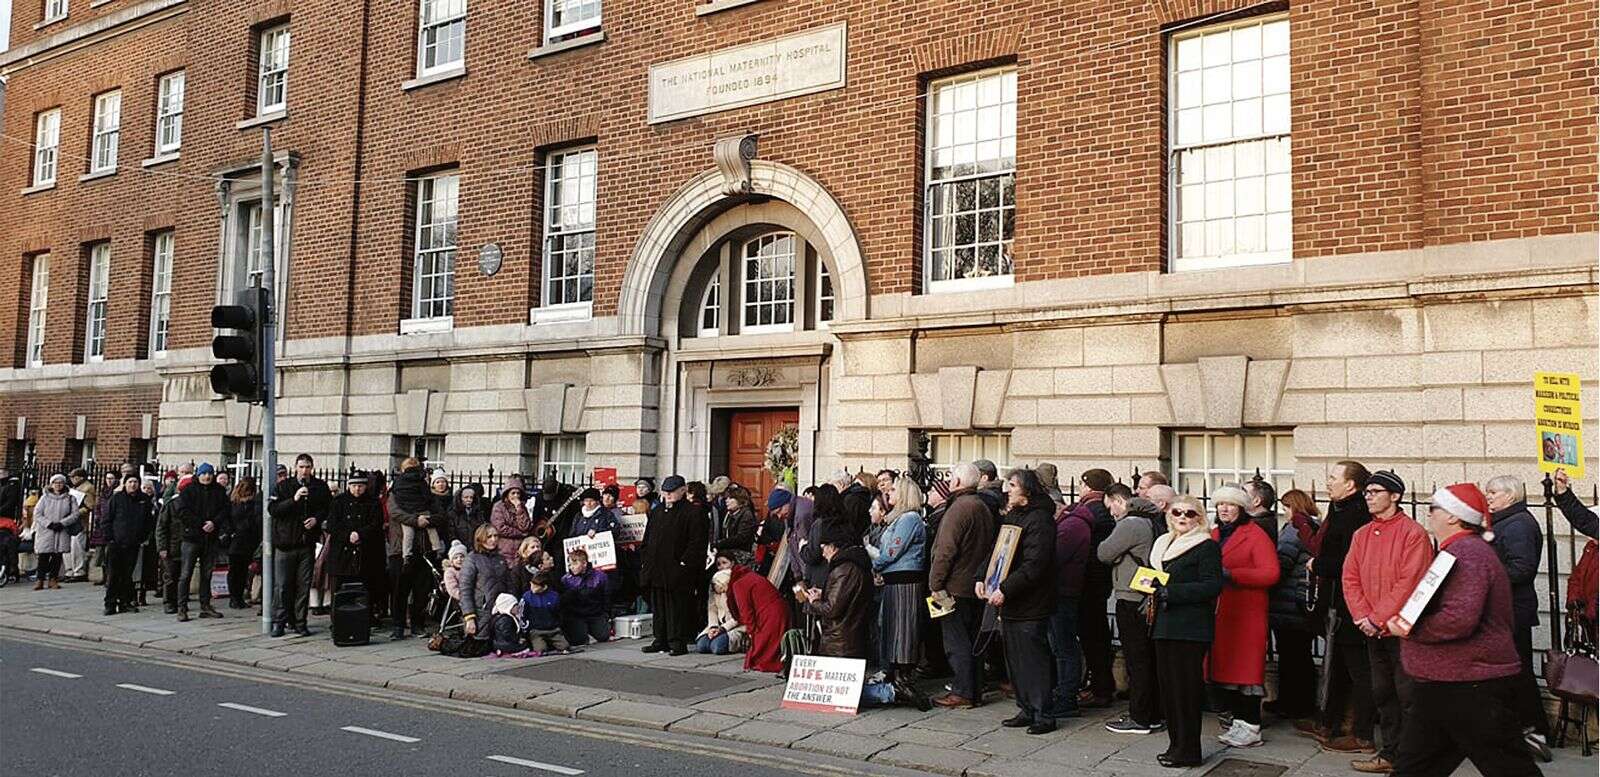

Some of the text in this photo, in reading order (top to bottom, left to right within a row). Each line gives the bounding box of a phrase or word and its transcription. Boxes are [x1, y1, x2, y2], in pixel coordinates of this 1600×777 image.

[661, 44, 831, 87] THE NATIONAL MATERNITY HOSPITAL
[706, 74, 778, 94] FOUNDED 1894
[565, 539, 581, 547] EVERY
[795, 657, 816, 667] EVERY
[792, 667, 823, 680] LIFE
[787, 691, 800, 700] THE
[788, 682, 825, 692] ABORTION
[834, 685, 849, 696] NOT
